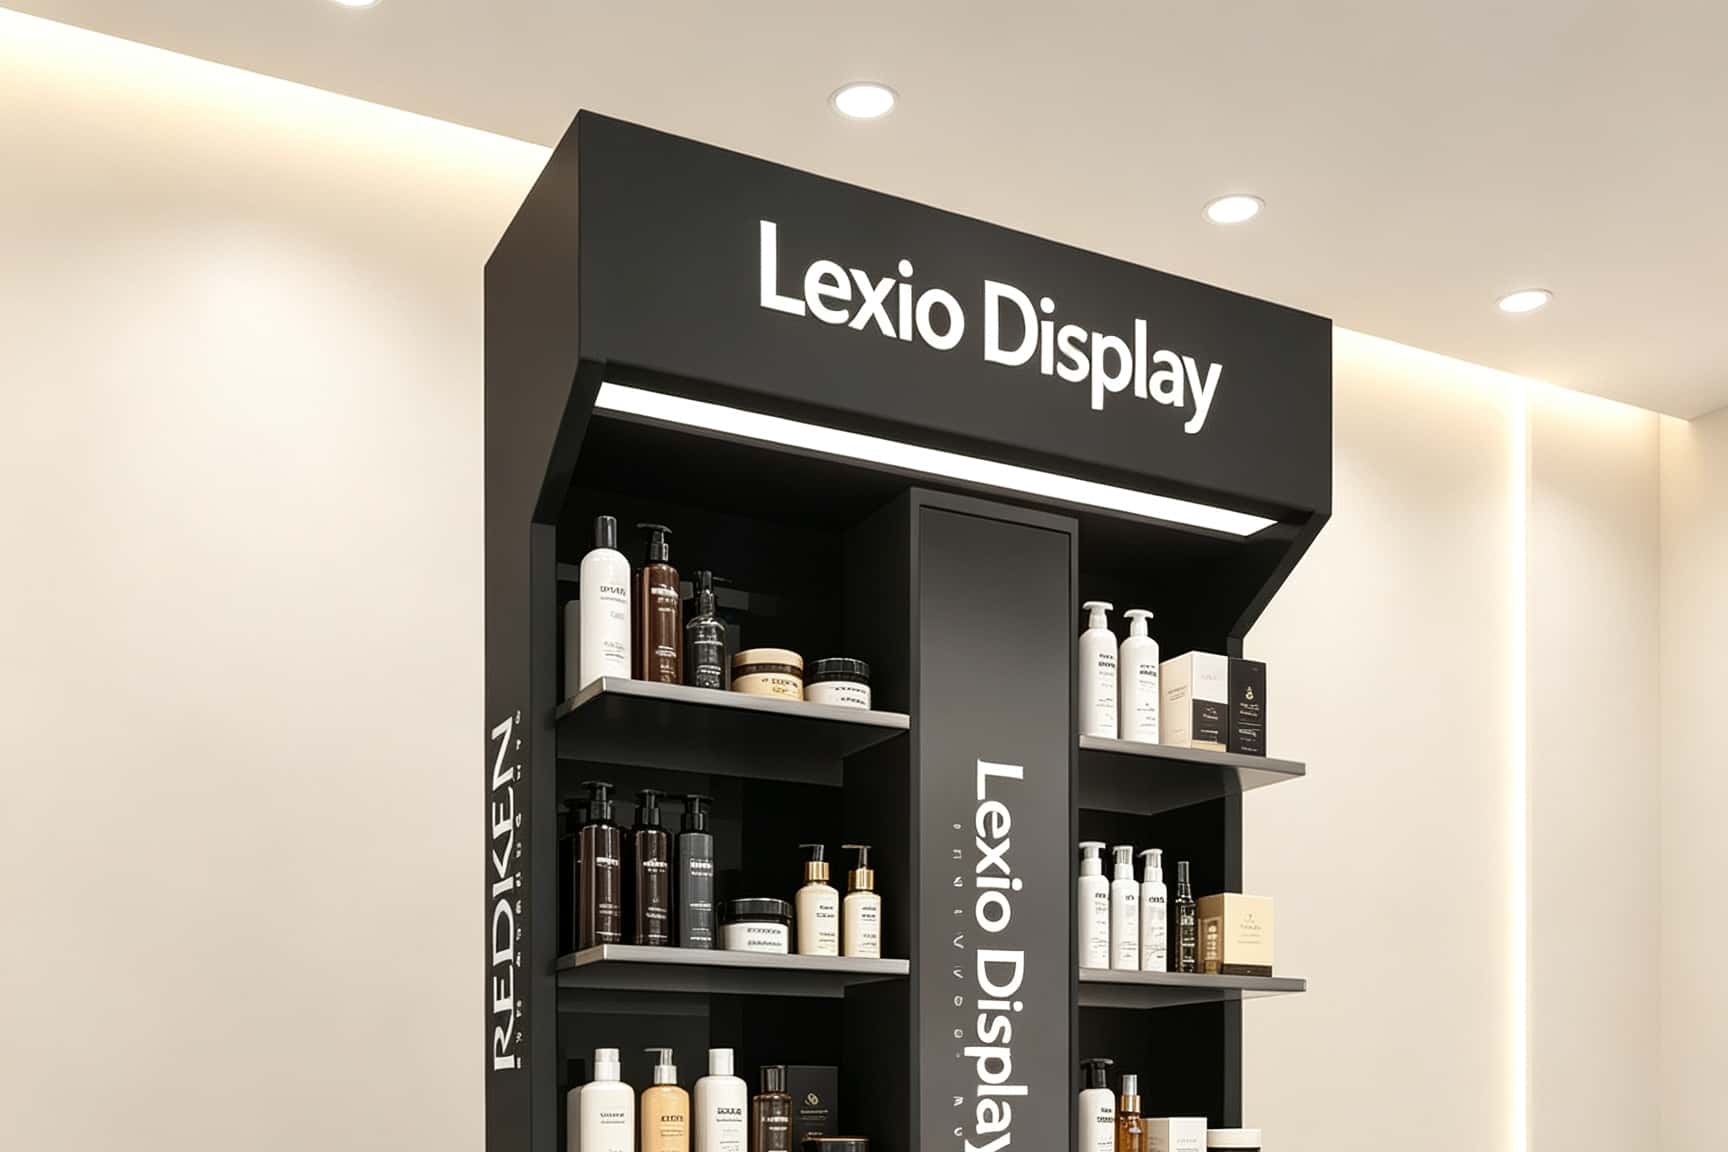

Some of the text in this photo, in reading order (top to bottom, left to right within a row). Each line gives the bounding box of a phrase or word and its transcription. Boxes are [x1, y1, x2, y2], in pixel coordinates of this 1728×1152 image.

[759, 220, 1223, 434] Lexio Display
[491, 716, 516, 1071] REDKEN
[975, 758, 1024, 933] Lexio
